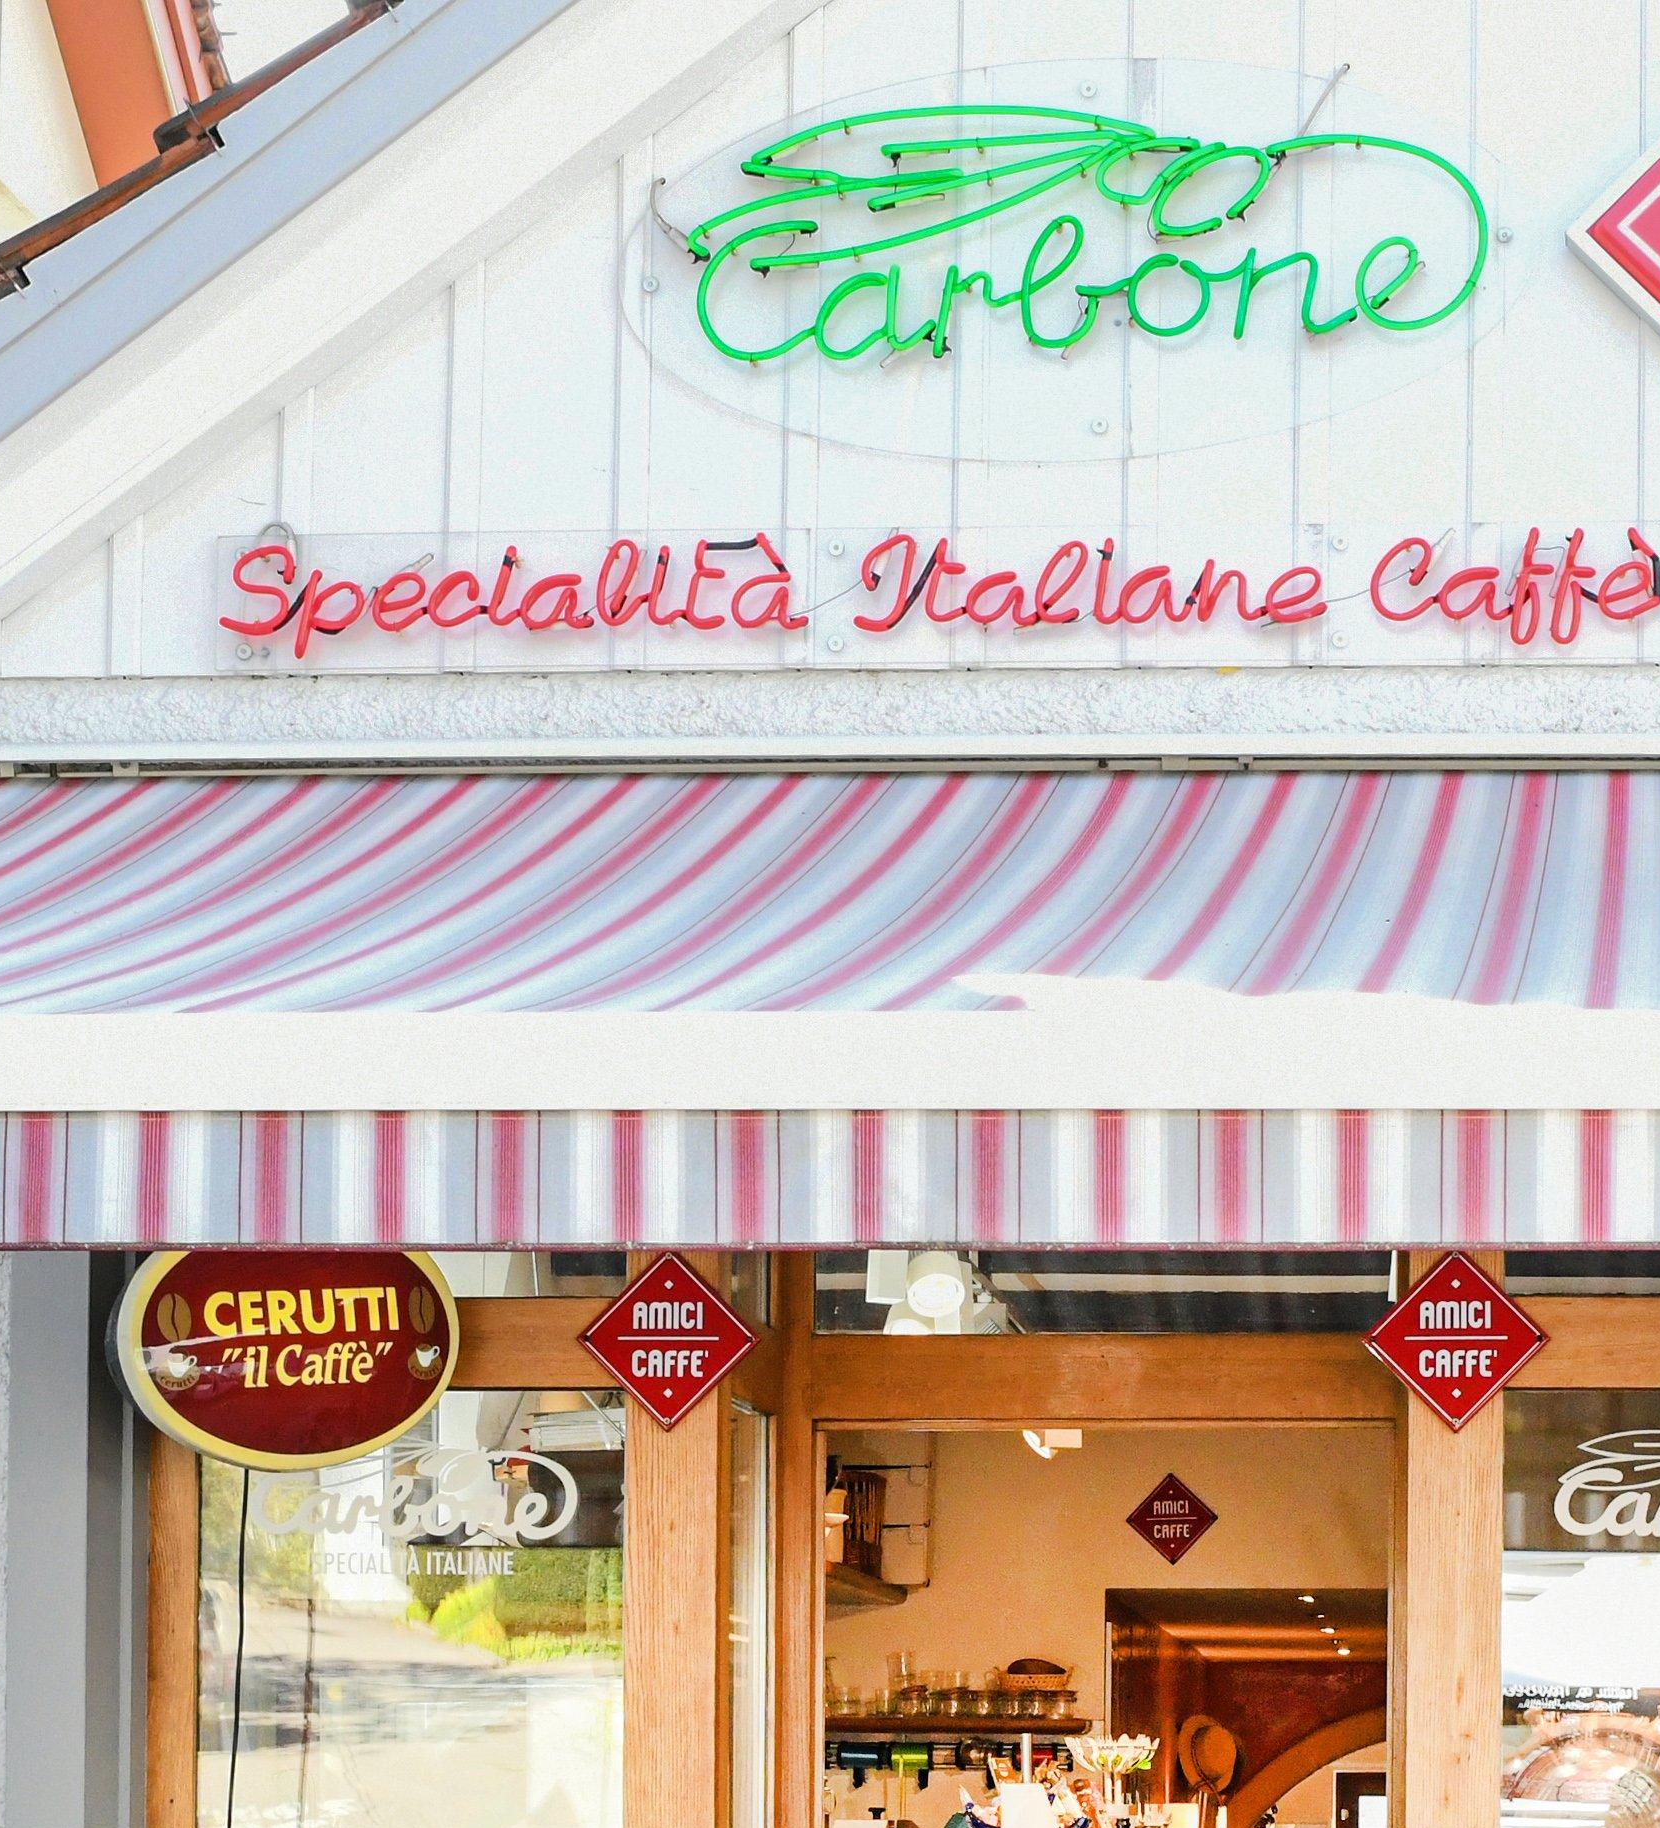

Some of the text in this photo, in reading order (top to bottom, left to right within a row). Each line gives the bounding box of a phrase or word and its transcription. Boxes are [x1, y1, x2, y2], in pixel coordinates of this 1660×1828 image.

[698, 140, 1489, 363] Carbone
[218, 532, 809, 659] Specialità
[853, 533, 1327, 631] Italiane
[203, 1286, 401, 1337] CERUTTI
[631, 1301, 705, 1331] AMICI
[1419, 1300, 1493, 1330] AMICI
[630, 1349, 710, 1379] CAFFE'
[1418, 1348, 1499, 1379] CAFFE'
[251, 1452, 578, 1540] Carbone
[1152, 1500, 1190, 1516] AMICI
[312, 1546, 514, 1576] SPECIALTÀ ITALIANE
